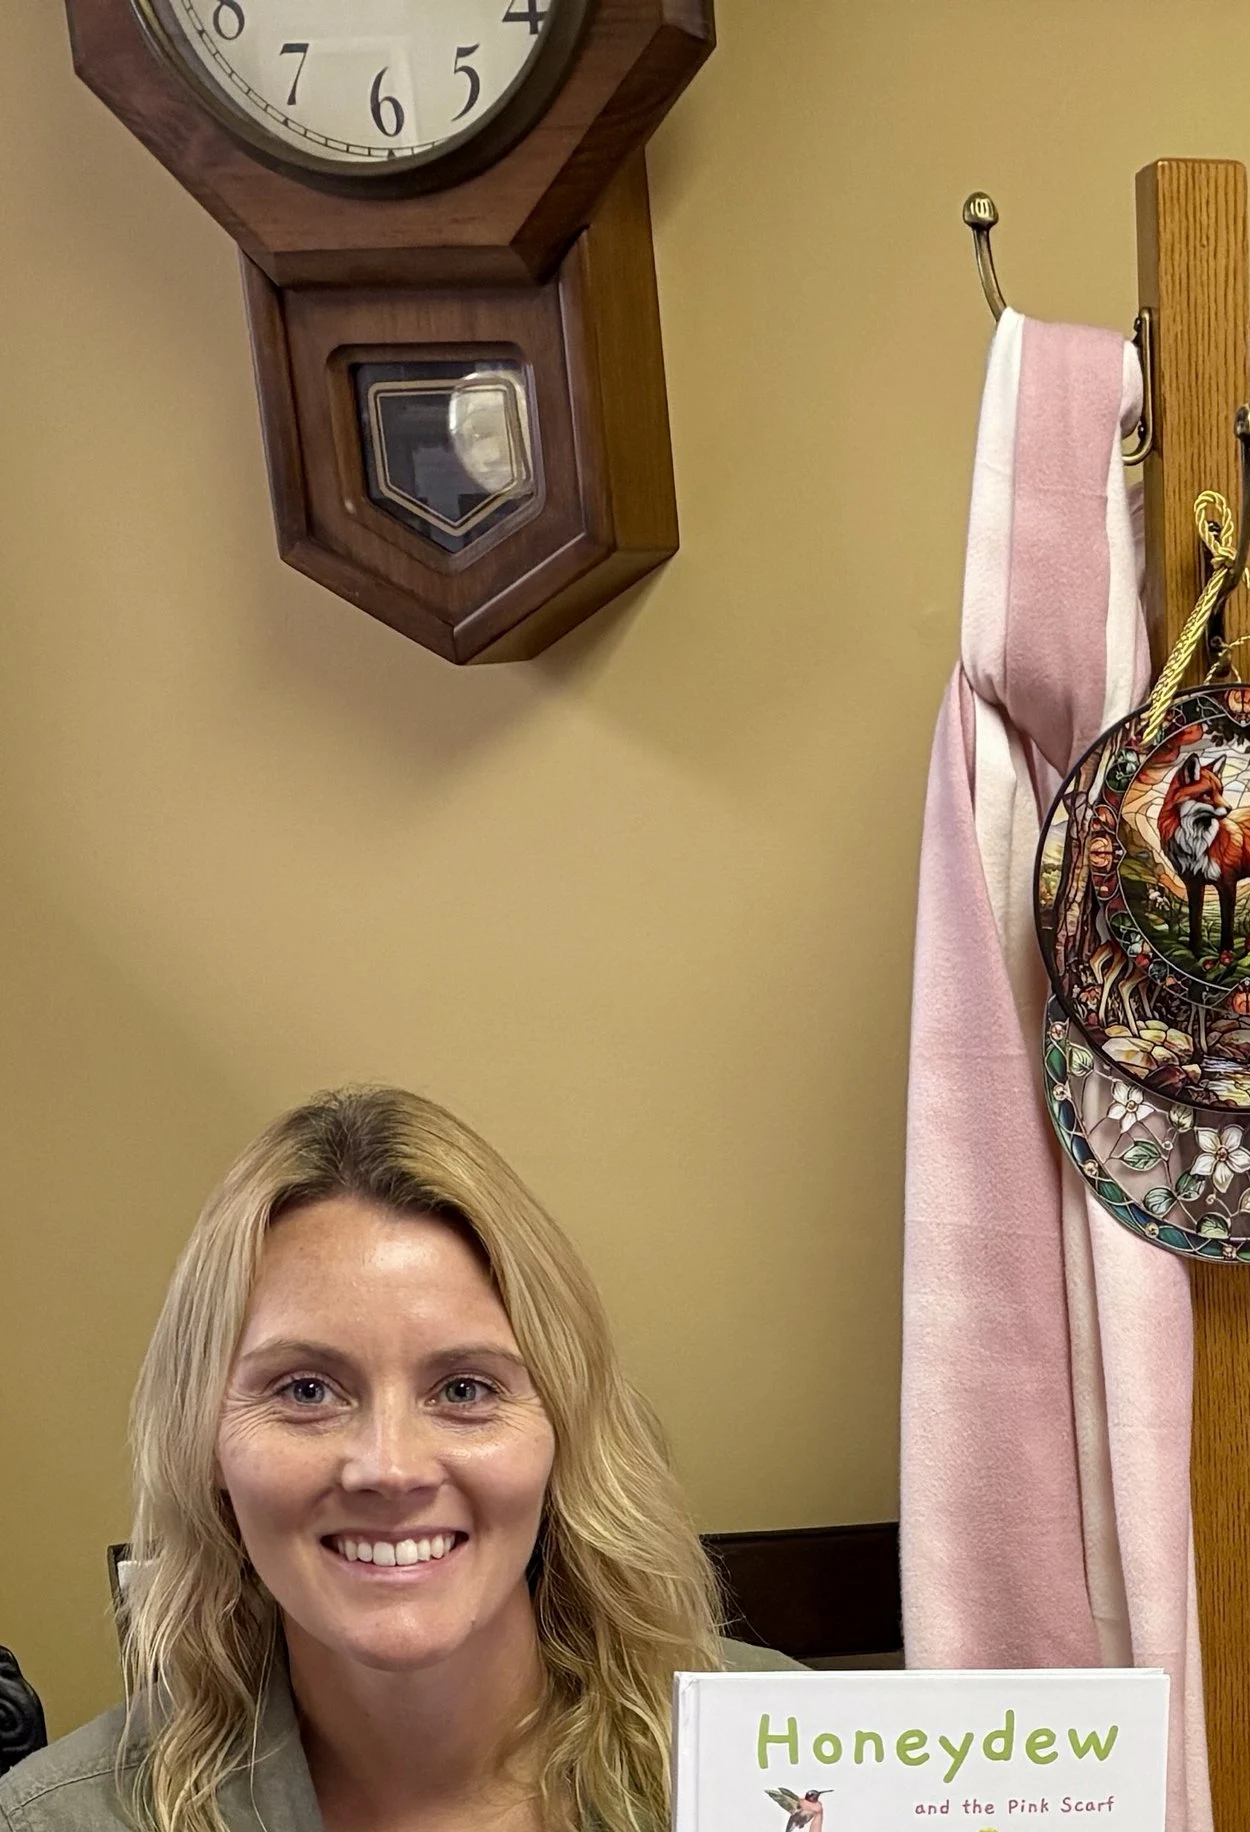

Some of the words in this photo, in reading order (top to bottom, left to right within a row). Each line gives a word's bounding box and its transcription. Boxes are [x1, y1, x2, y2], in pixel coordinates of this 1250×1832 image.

[279, 43, 310, 106] 7
[370, 67, 404, 137] 6
[451, 43, 481, 122] 5
[757, 1710, 1119, 1783] Honeydew
[915, 1798, 951, 1815] and
[963, 1797, 995, 1815] the
[1008, 1798, 1049, 1815] Pink
[1061, 1795, 1115, 1814] Scarf
